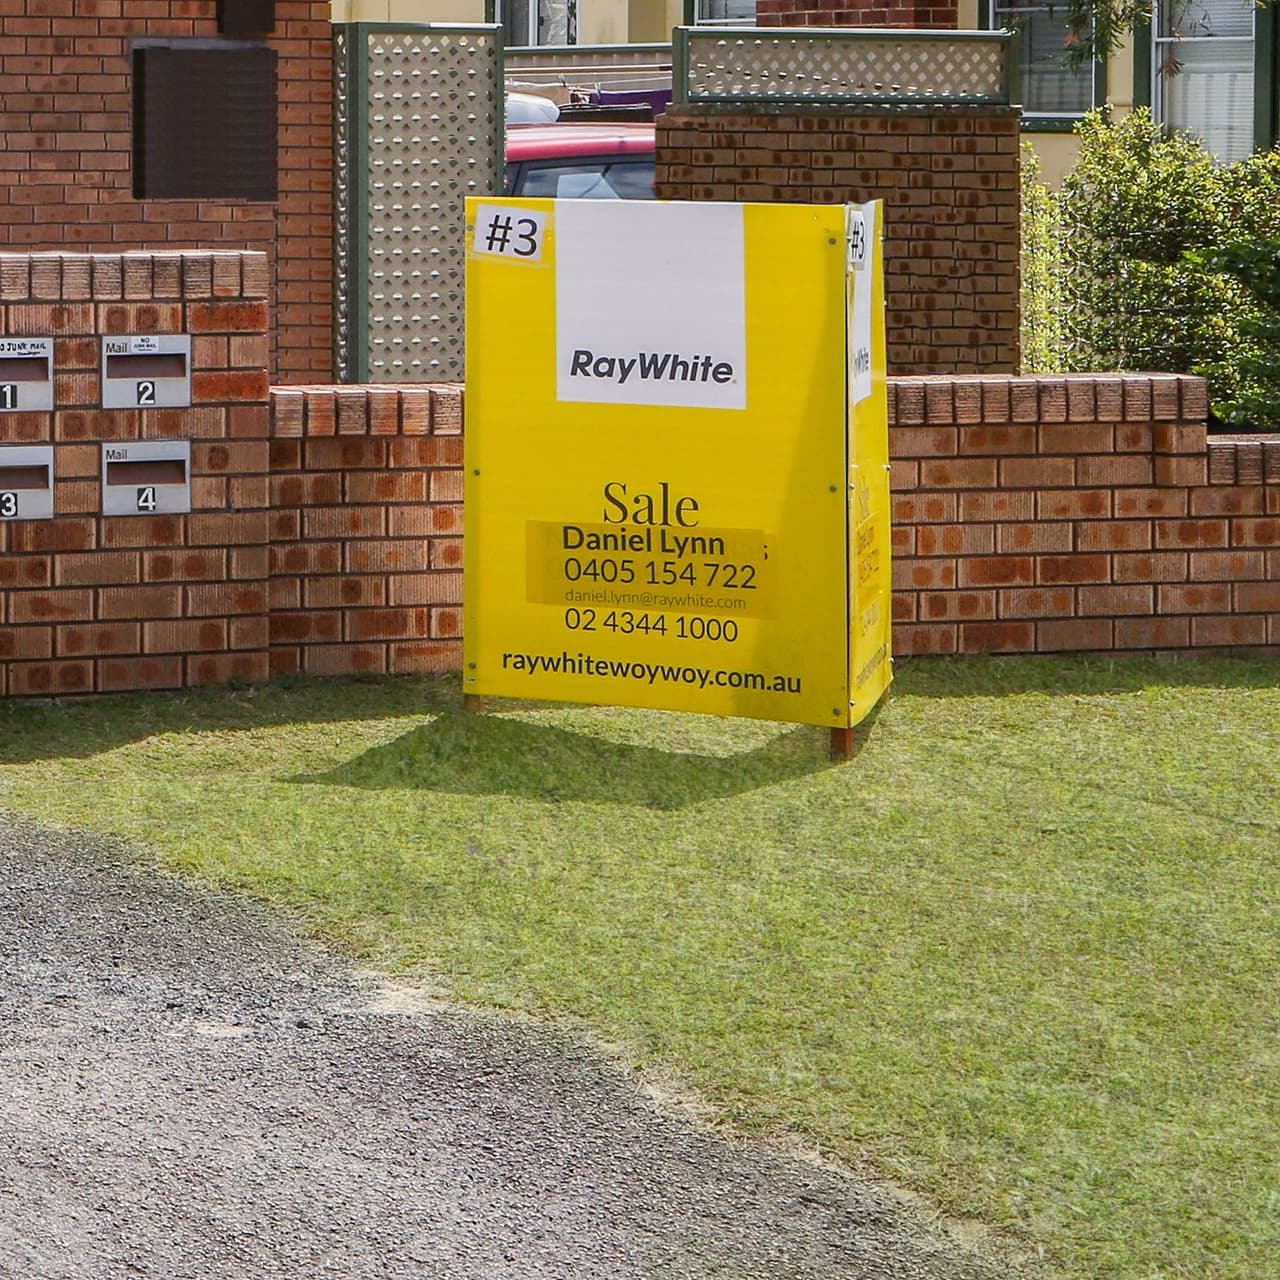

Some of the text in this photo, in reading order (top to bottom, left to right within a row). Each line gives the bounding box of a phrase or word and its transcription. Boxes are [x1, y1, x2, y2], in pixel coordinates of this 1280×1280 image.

[486, 215, 537, 256] #3
[851, 220, 866, 260] #3
[7, 342, 27, 351] JUNK
[30, 342, 46, 350] MAIL
[106, 343, 128, 353] Mail
[2, 385, 12, 408] 1
[139, 382, 154, 405] 2
[106, 449, 128, 460] Mail
[1, 493, 17, 516] 3
[138, 488, 156, 511] 4
[603, 481, 699, 528] Sale
[562, 526, 724, 558] Daniel Lynn
[564, 558, 757, 589] 0405 154 722
[565, 588, 746, 609] daniel.lynn@raywhite.com
[565, 608, 738, 642] 02 4344 1000
[502, 651, 802, 693] raywhitewoywoy.com.au
